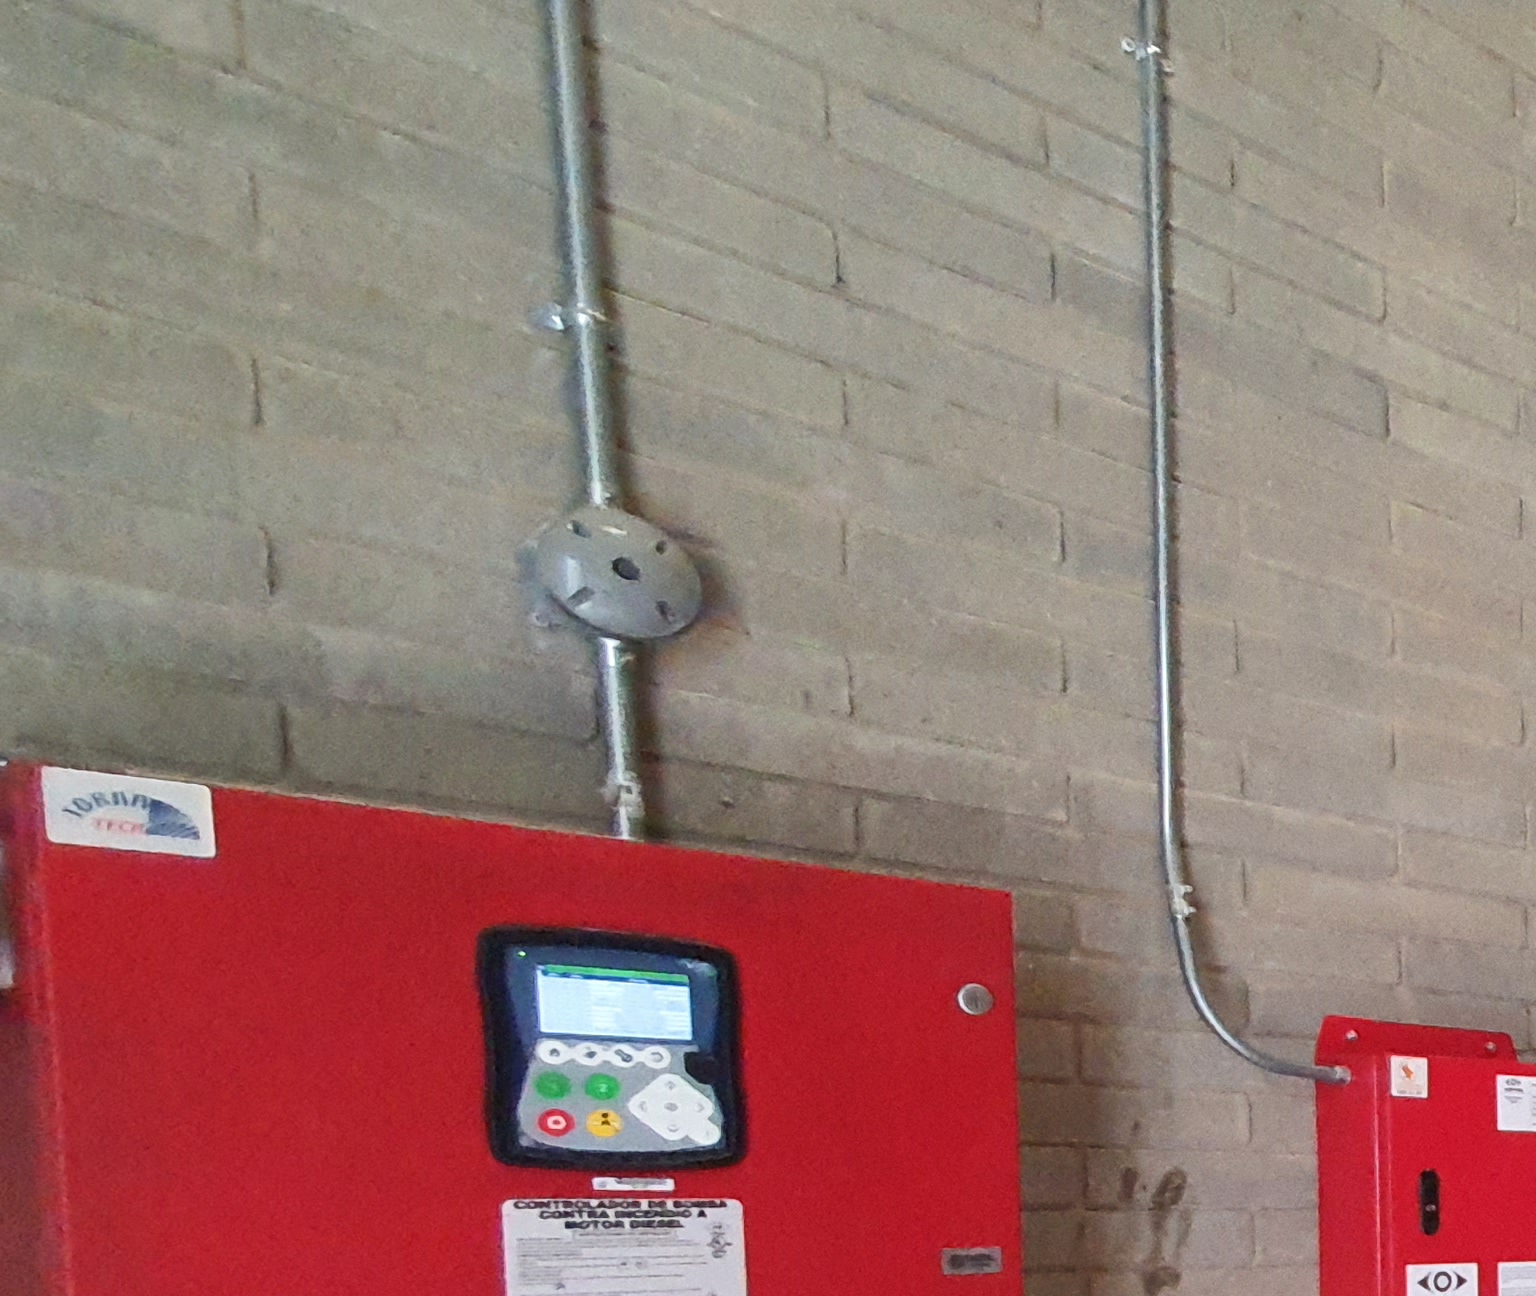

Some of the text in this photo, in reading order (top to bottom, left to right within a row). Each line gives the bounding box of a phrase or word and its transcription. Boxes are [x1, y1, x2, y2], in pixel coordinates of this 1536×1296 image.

[513, 1200, 642, 1209] CONTROLADOR
[647, 1200, 667, 1209] DE
[539, 1210, 708, 1219] CONTRA INCENDIO A
[564, 1220, 625, 1229] MOTOR
